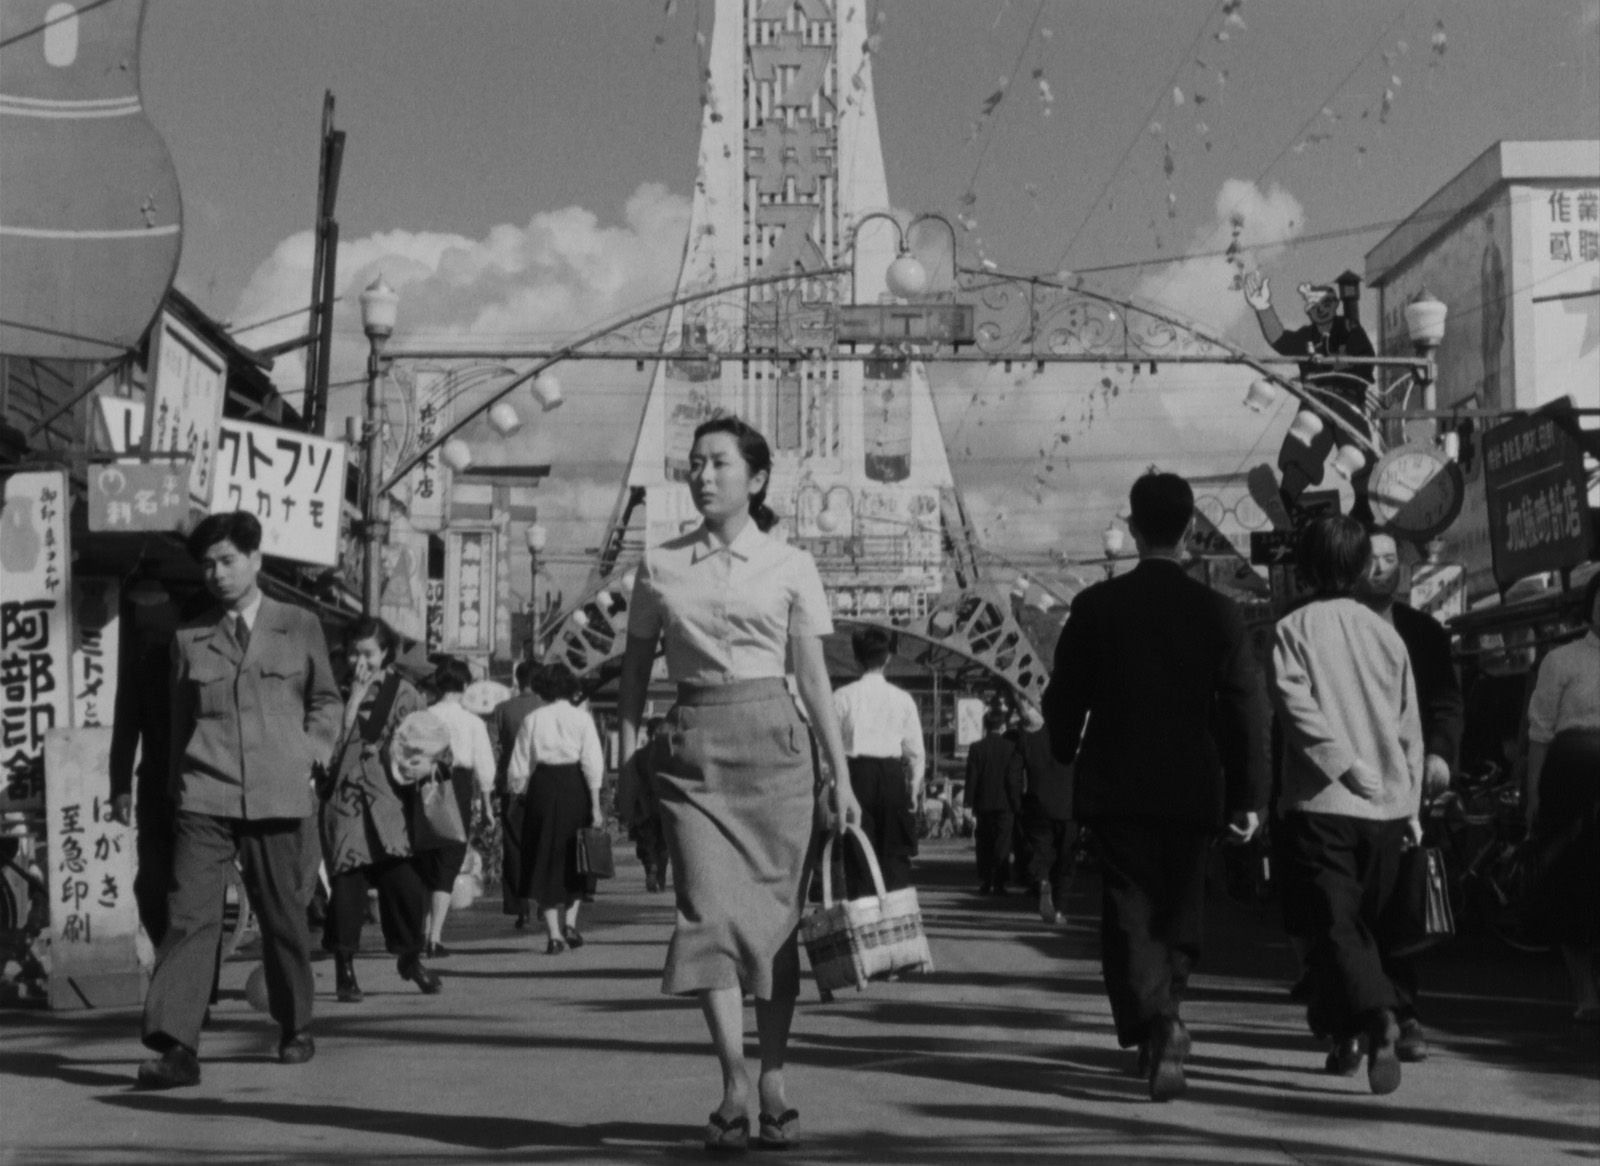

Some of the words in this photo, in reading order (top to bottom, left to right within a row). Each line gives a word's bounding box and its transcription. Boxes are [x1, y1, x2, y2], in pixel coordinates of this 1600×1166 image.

[77, 629, 104, 730] ミトメと
[58, 804, 92, 944] 至急印刷
